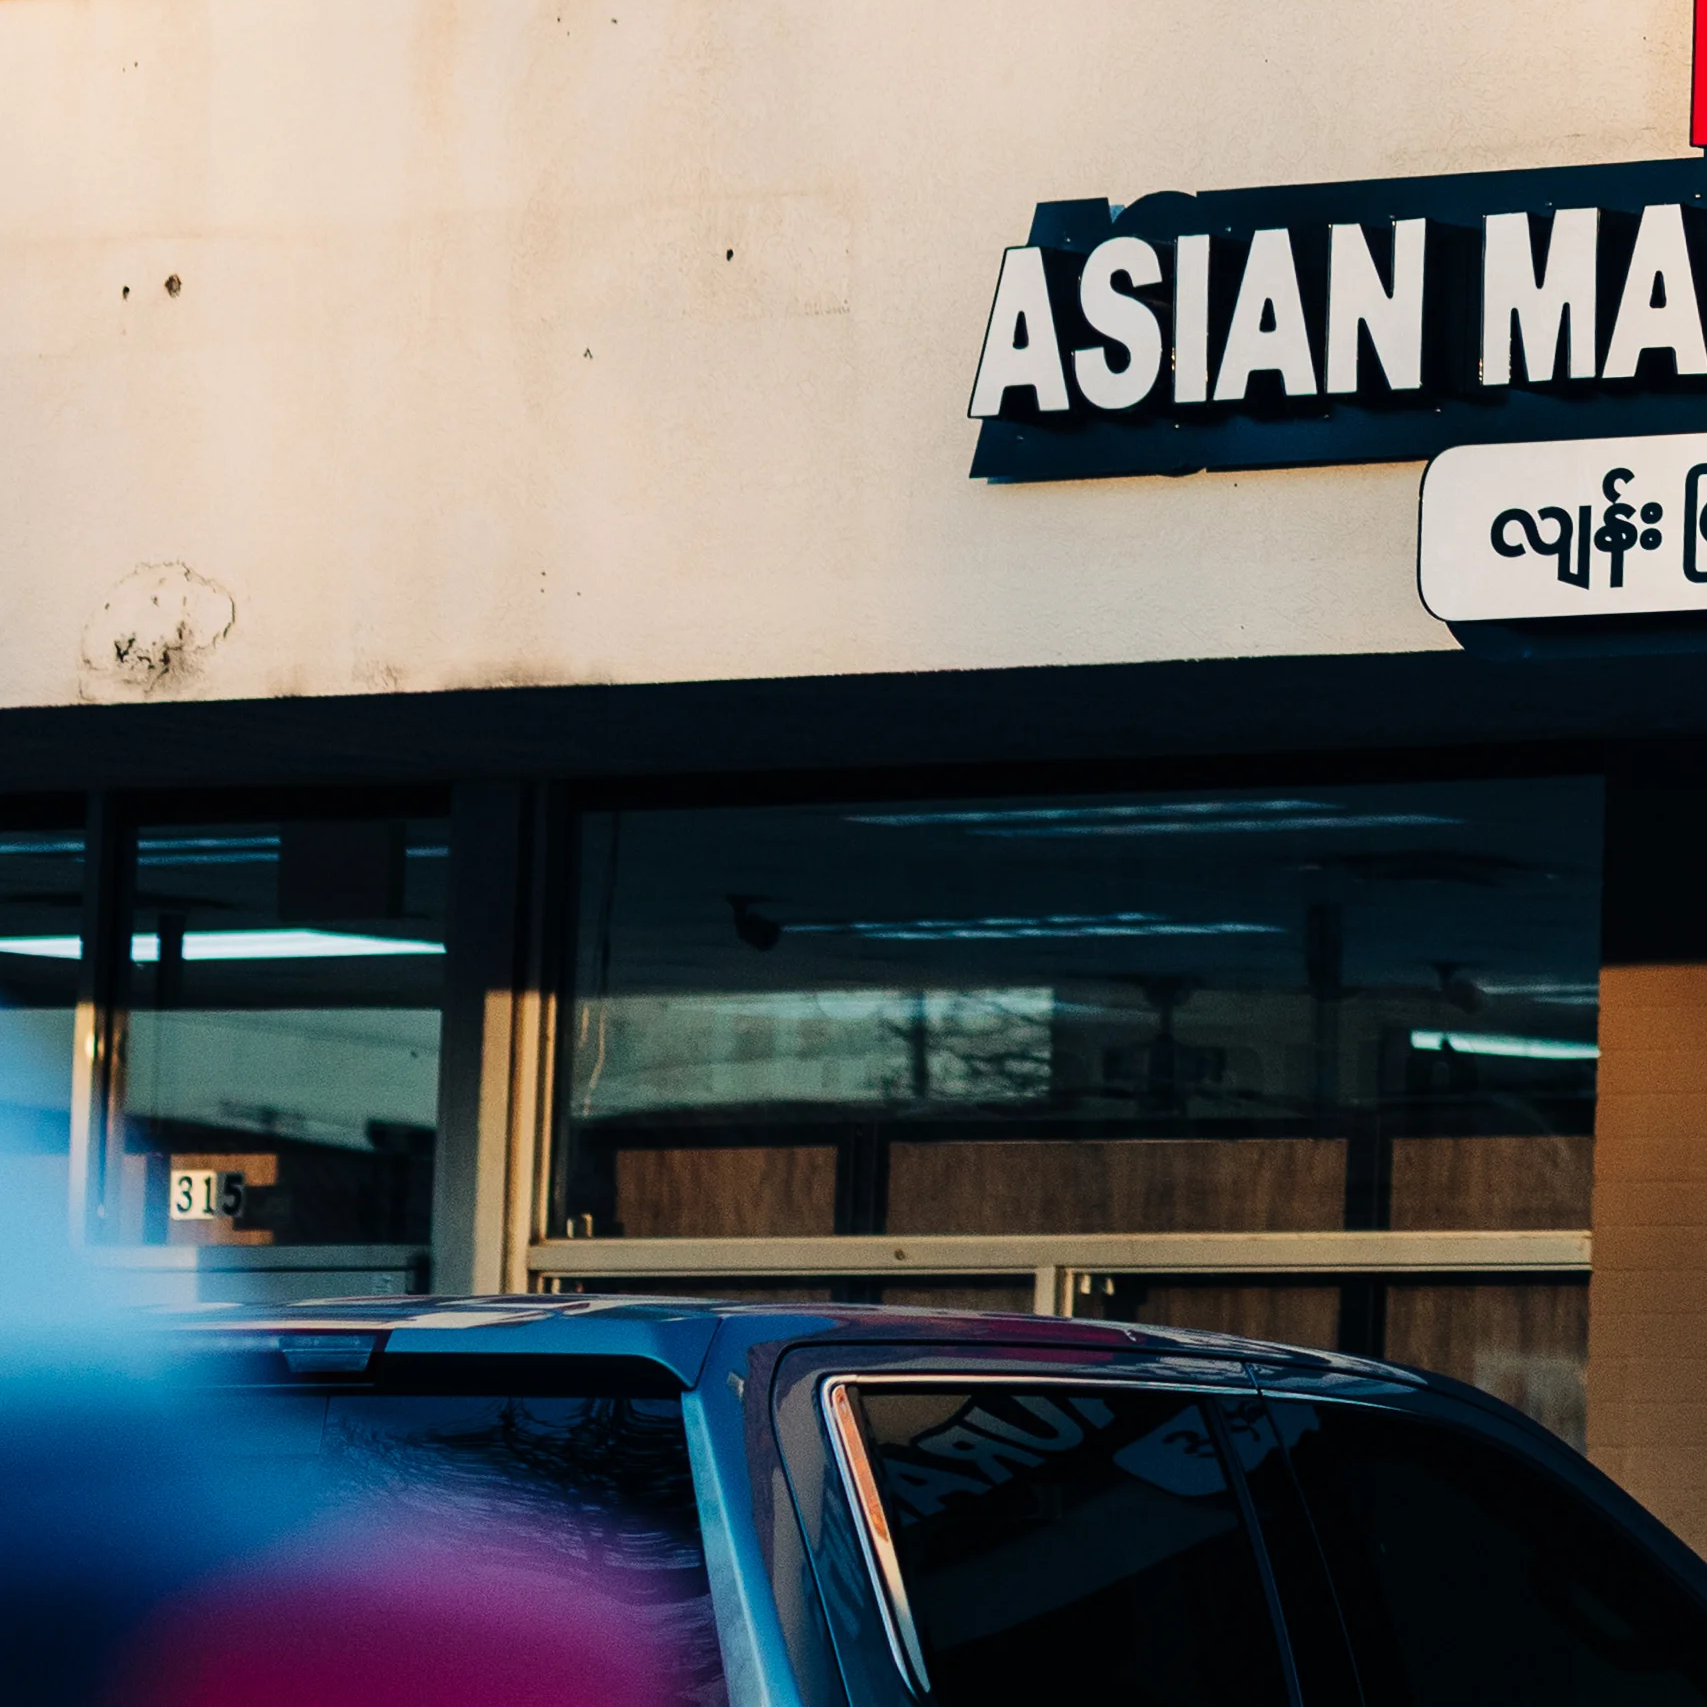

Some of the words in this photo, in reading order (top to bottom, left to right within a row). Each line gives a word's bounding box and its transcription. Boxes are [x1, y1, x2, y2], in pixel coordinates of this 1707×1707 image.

[970, 218, 1426, 418] ASIAN
[1490, 467, 1663, 590] လျန်း
[176, 1175, 243, 1216] 315
